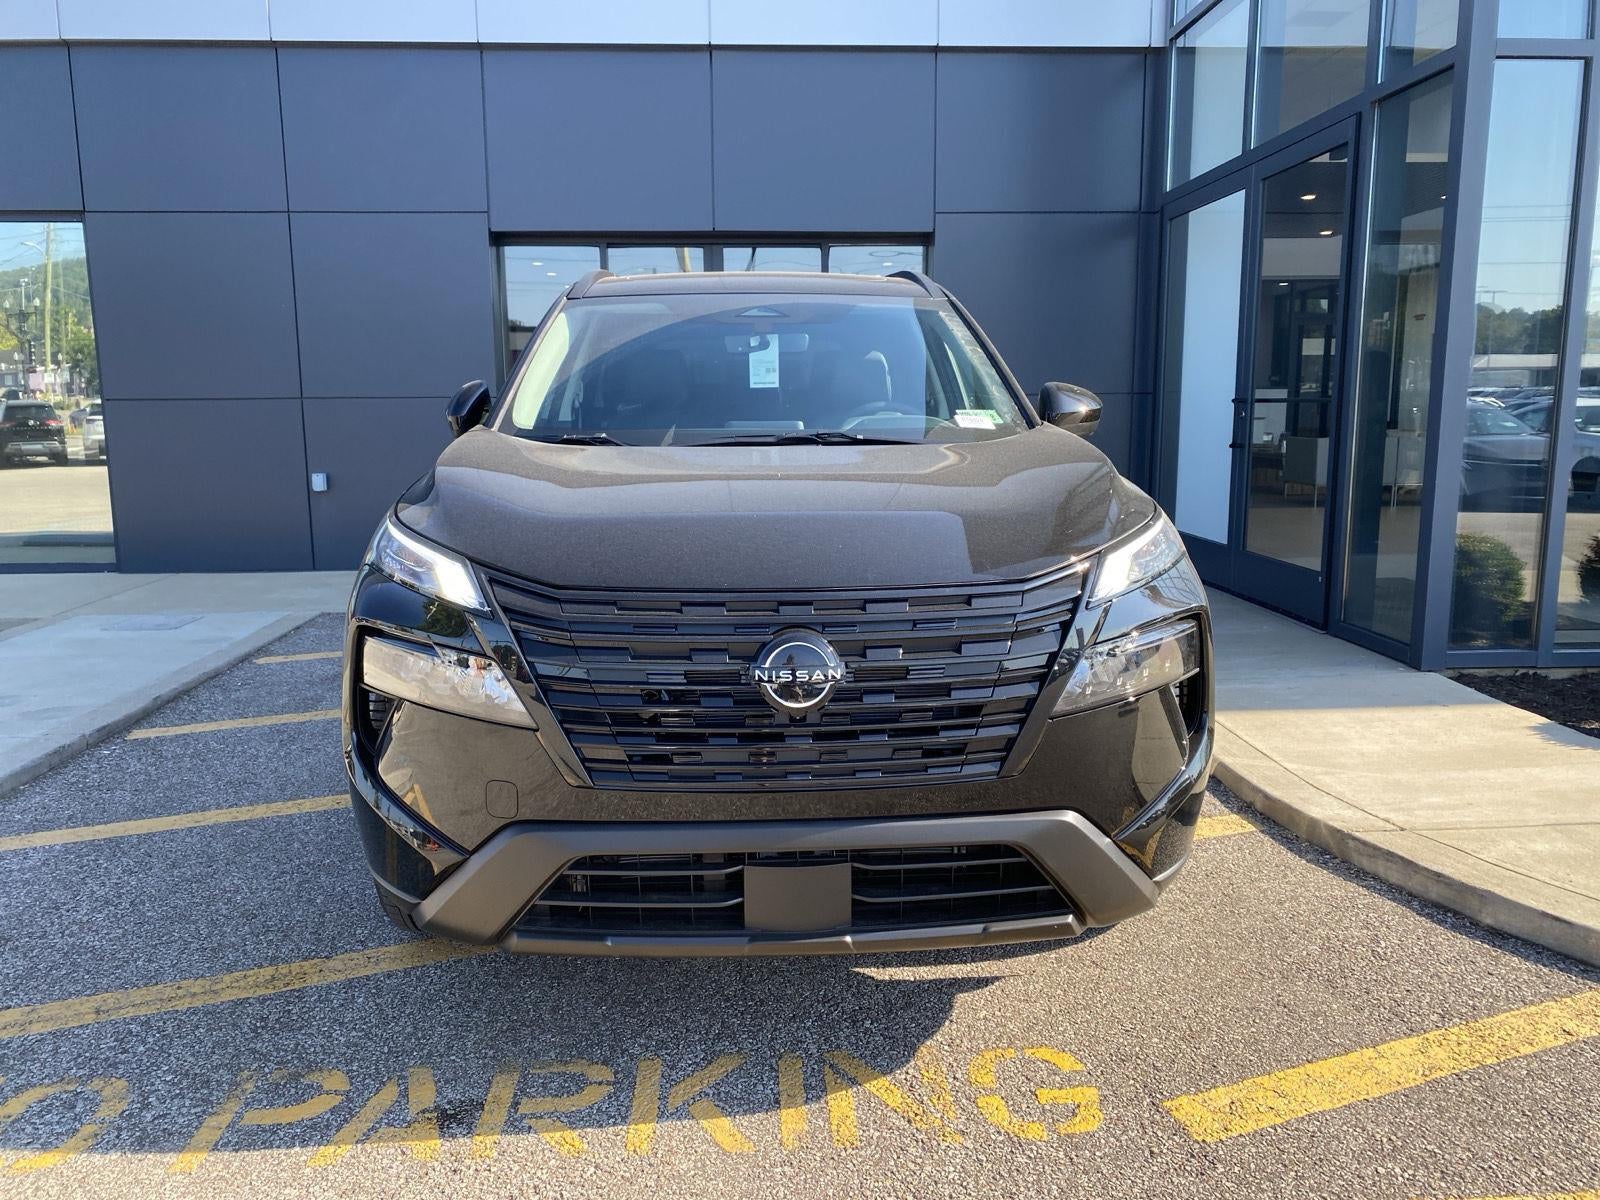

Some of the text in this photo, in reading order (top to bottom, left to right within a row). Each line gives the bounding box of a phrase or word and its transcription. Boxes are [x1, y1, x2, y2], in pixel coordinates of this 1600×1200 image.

[755, 668, 841, 682] NISSAN
[0, 1045, 1104, 1175] O PARKING
